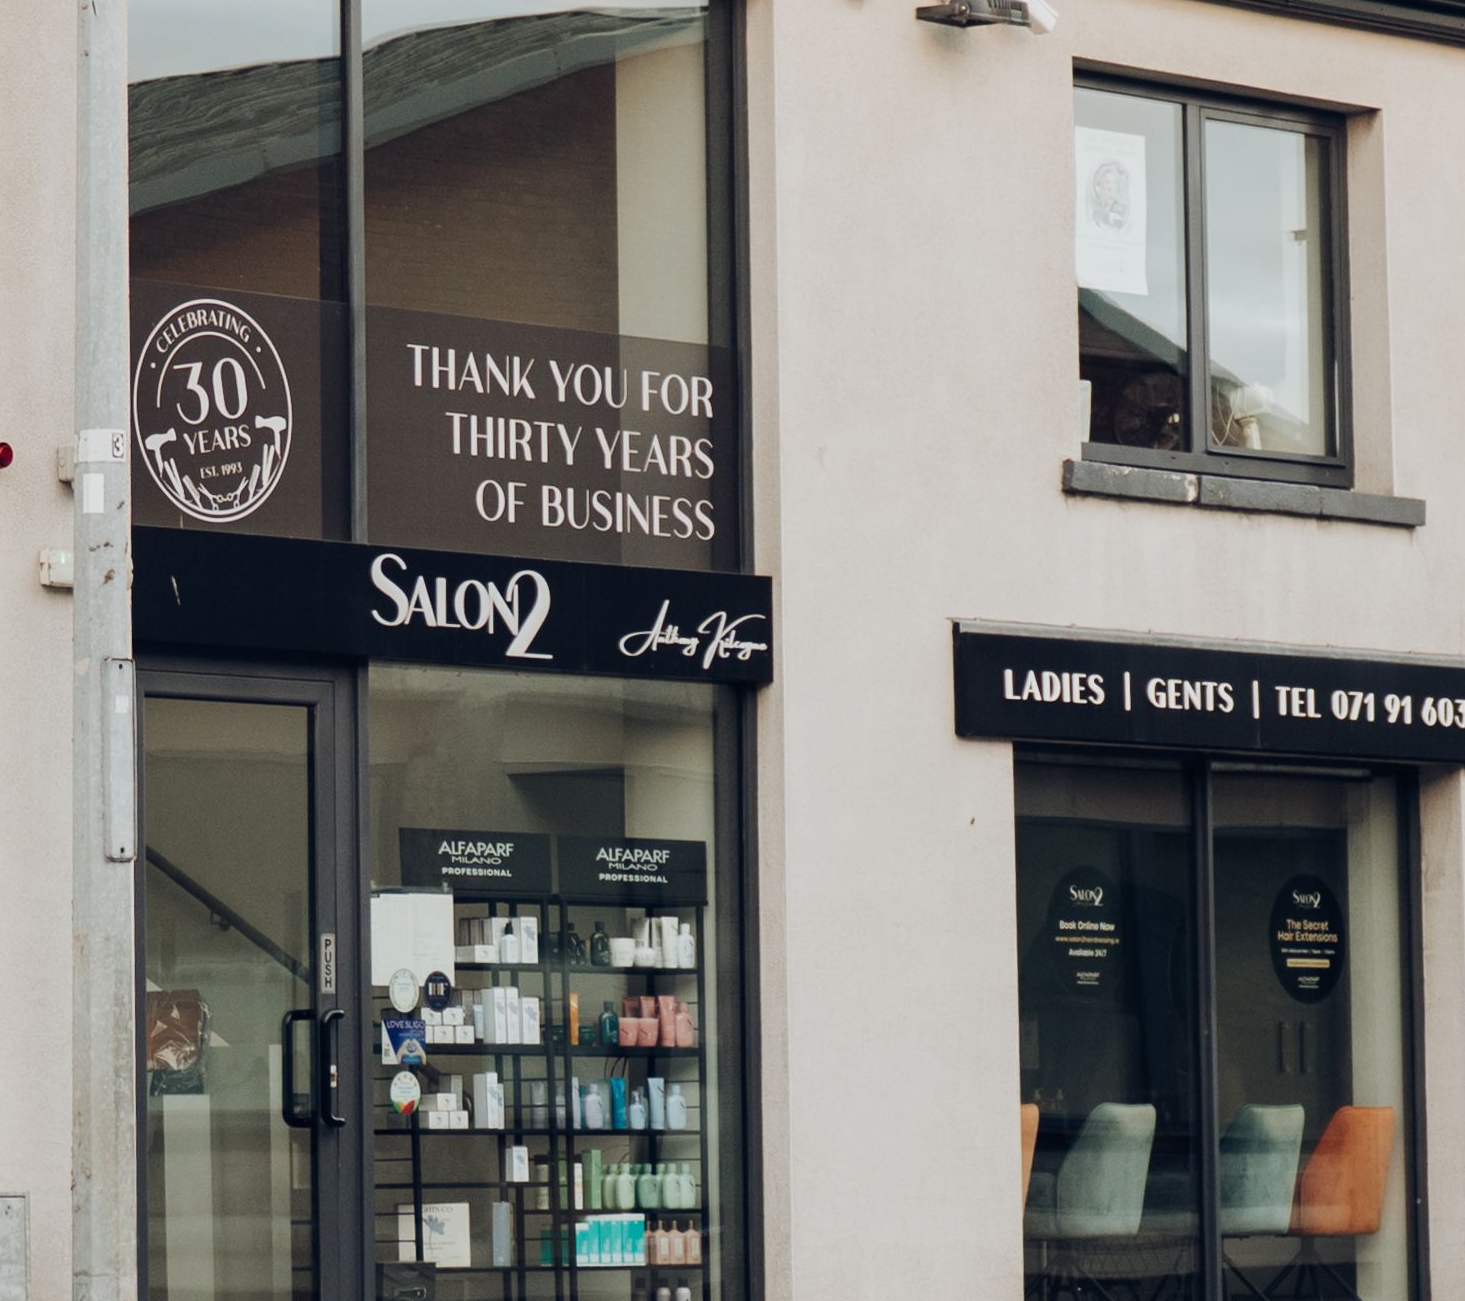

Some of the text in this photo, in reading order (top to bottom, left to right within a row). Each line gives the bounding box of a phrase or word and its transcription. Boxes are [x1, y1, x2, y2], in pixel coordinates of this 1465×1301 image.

[156, 308, 252, 353] CELEBRATING
[406, 343, 713, 418] THANK YOU FOR
[173, 357, 248, 425] 30
[183, 424, 252, 455] YEARS
[445, 411, 715, 480] THIRTY YEARS
[221, 461, 243, 475] 1993
[475, 479, 715, 541] OF BUSINESS
[1003, 668, 1106, 706] LADIES
[1146, 677, 1235, 714] GENTS
[1274, 685, 1322, 719] TEL
[1330, 689, 1375, 723] 071
[1383, 693, 1412, 725] 91
[438, 840, 515, 858] ALFAPARF
[595, 847, 671, 864] ALFAPARF
[451, 856, 502, 866] MILANO
[608, 862, 659, 872] MILANO
[441, 867, 513, 878] PROFESSIONAL
[598, 872, 669, 884] PROFESSIONAL
[1059, 920, 1116, 932] Book Online Now
[1286, 918, 1330, 931] The Secret
[1277, 930, 1339, 943] Hair Extensions
[324, 938, 332, 989] PUSH
